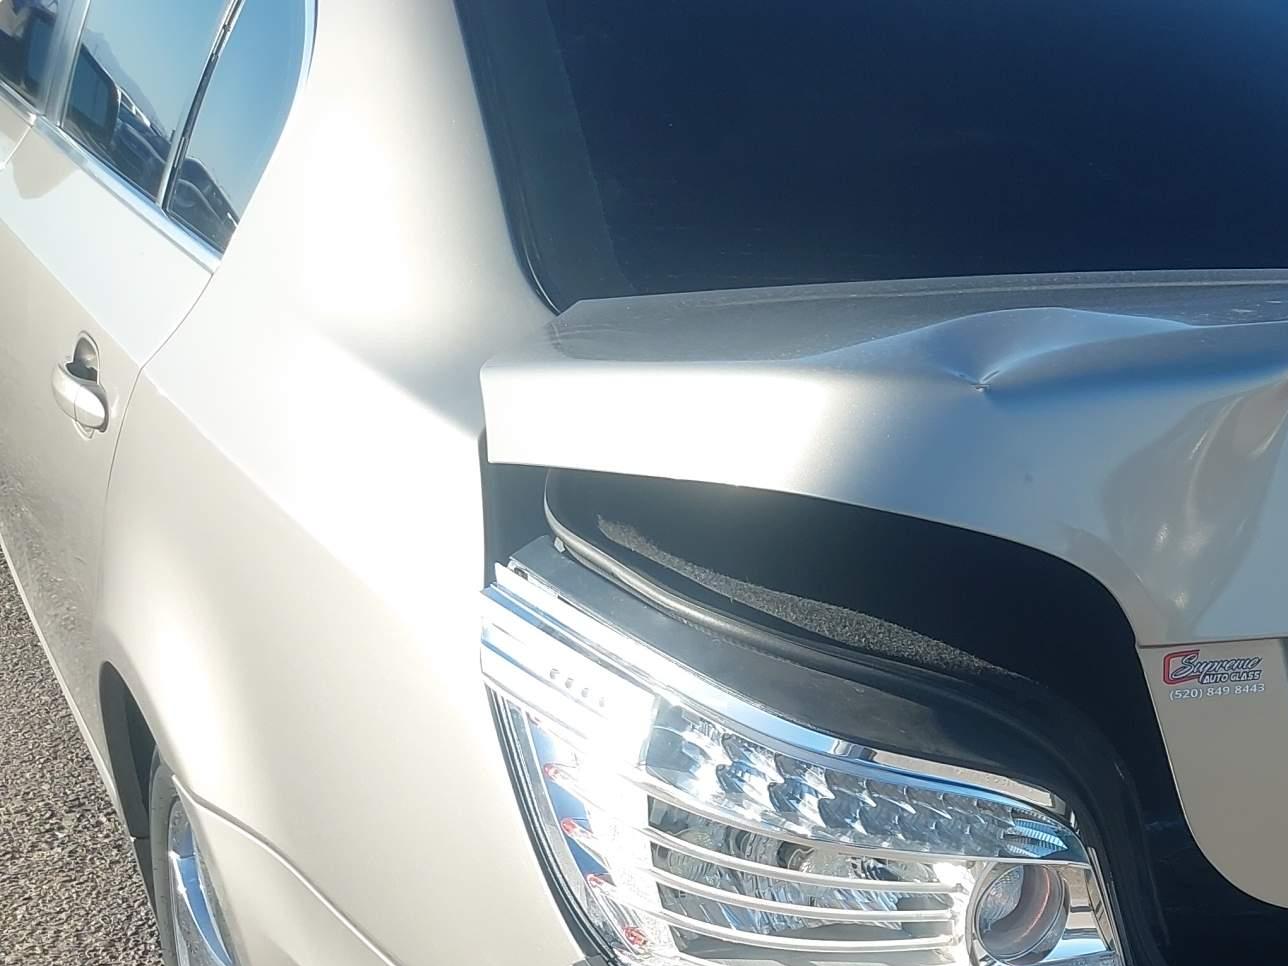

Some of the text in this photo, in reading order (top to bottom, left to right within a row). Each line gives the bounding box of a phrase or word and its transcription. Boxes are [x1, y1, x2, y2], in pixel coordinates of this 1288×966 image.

[1169, 652, 1263, 682] Supreme
[1203, 671, 1261, 684] AUTO GLASS
[1169, 683, 1265, 701] (520) 849 8443
